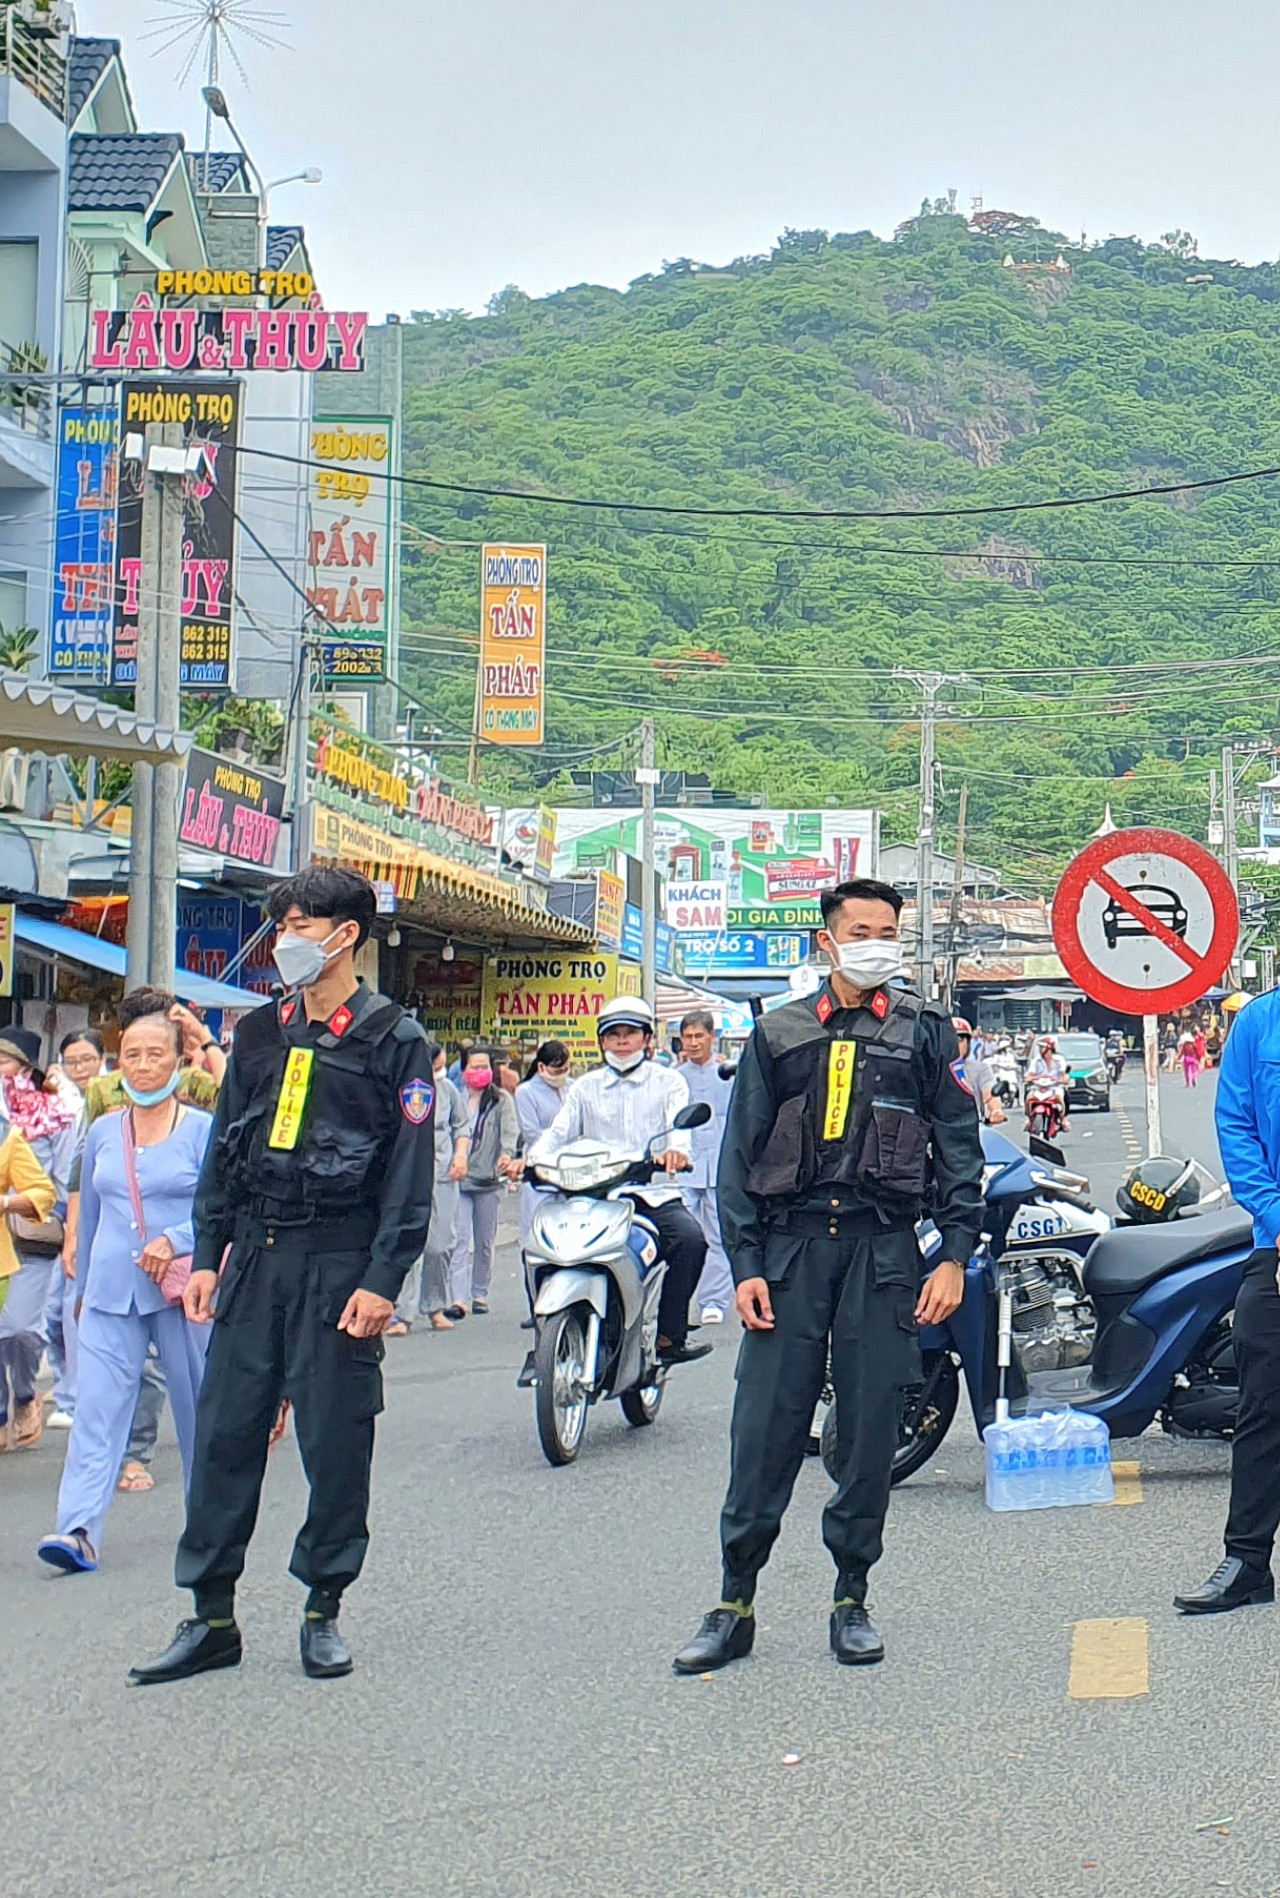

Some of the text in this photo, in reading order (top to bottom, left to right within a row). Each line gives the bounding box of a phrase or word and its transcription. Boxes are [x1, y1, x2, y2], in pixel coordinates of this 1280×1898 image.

[157, 267, 313, 302] PHÒNG TRỌ
[91, 292, 198, 370] LÂU
[222, 291, 370, 371] THỦY
[126, 385, 234, 432] PHÒNG TRỌ
[307, 514, 377, 567] TẤN
[120, 540, 229, 617] TỦY
[486, 550, 518, 585] PHÒNG
[491, 588, 535, 637] TẤN
[484, 654, 539, 697] PHÁT
[214, 764, 244, 795] PHÒNG
[180, 778, 224, 849] LÂU
[668, 884, 722, 902] KHÁCH
[676, 906, 723, 928] SAM
[748, 909, 780, 924] GIA
[744, 941, 756, 953] 2
[496, 956, 562, 979] PHÒNG
[568, 960, 607, 984] TRỌ
[496, 981, 541, 1016] TẤN
[547, 986, 606, 1016] PHÁT
[277, 1051, 305, 1144] POLICE
[829, 1043, 849, 1136] POLICE
[1130, 1180, 1168, 1212] CSCD
